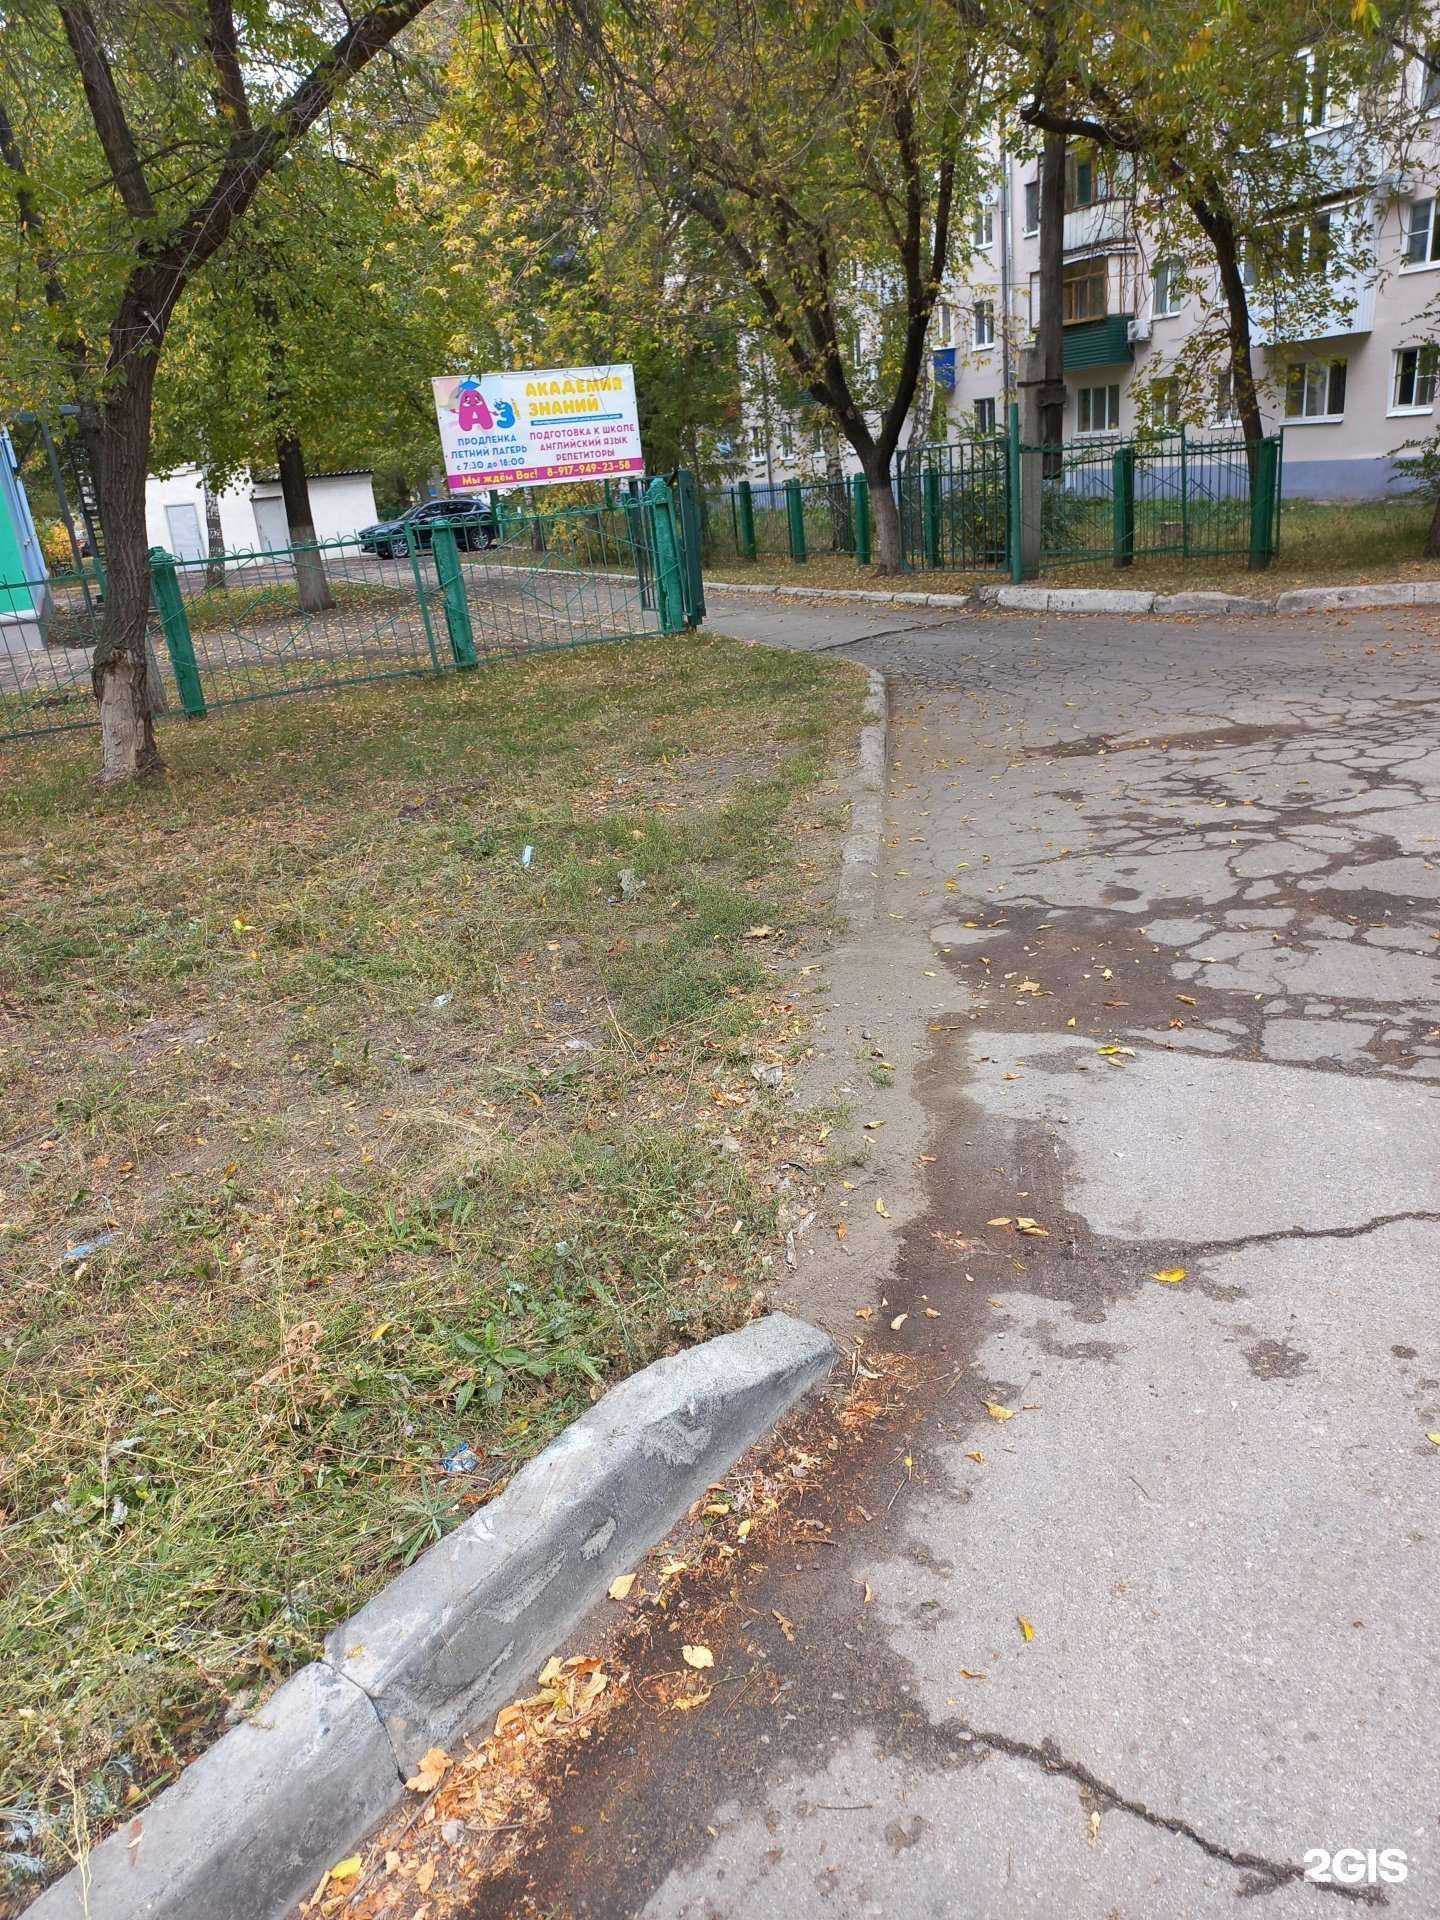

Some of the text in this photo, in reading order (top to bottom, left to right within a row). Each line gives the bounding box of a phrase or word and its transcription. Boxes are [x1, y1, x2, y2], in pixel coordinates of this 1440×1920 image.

[525, 376, 623, 397] АКАДЕМИЯ
[529, 394, 599, 417] ЗНАНИЙ
[529, 424, 635, 440] ПОДГОТОВКА К ШКОЛЕ
[457, 434, 517, 446] ПРОДЛЕНКА
[540, 436, 628, 451] АНГЛИЙСКИЙ ЯЗЫК
[451, 445, 528, 459] ЛЕТНИЙ ЛАГЕРЬ
[556, 449, 615, 461] РЕПЕТИТОРЫ
[463, 461, 484, 470] 7:30
[499, 457, 525, 467] 18:00
[547, 460, 631, 477] 8-917-949-23-58
[462, 469, 538, 486] Мы ждём Вас!
